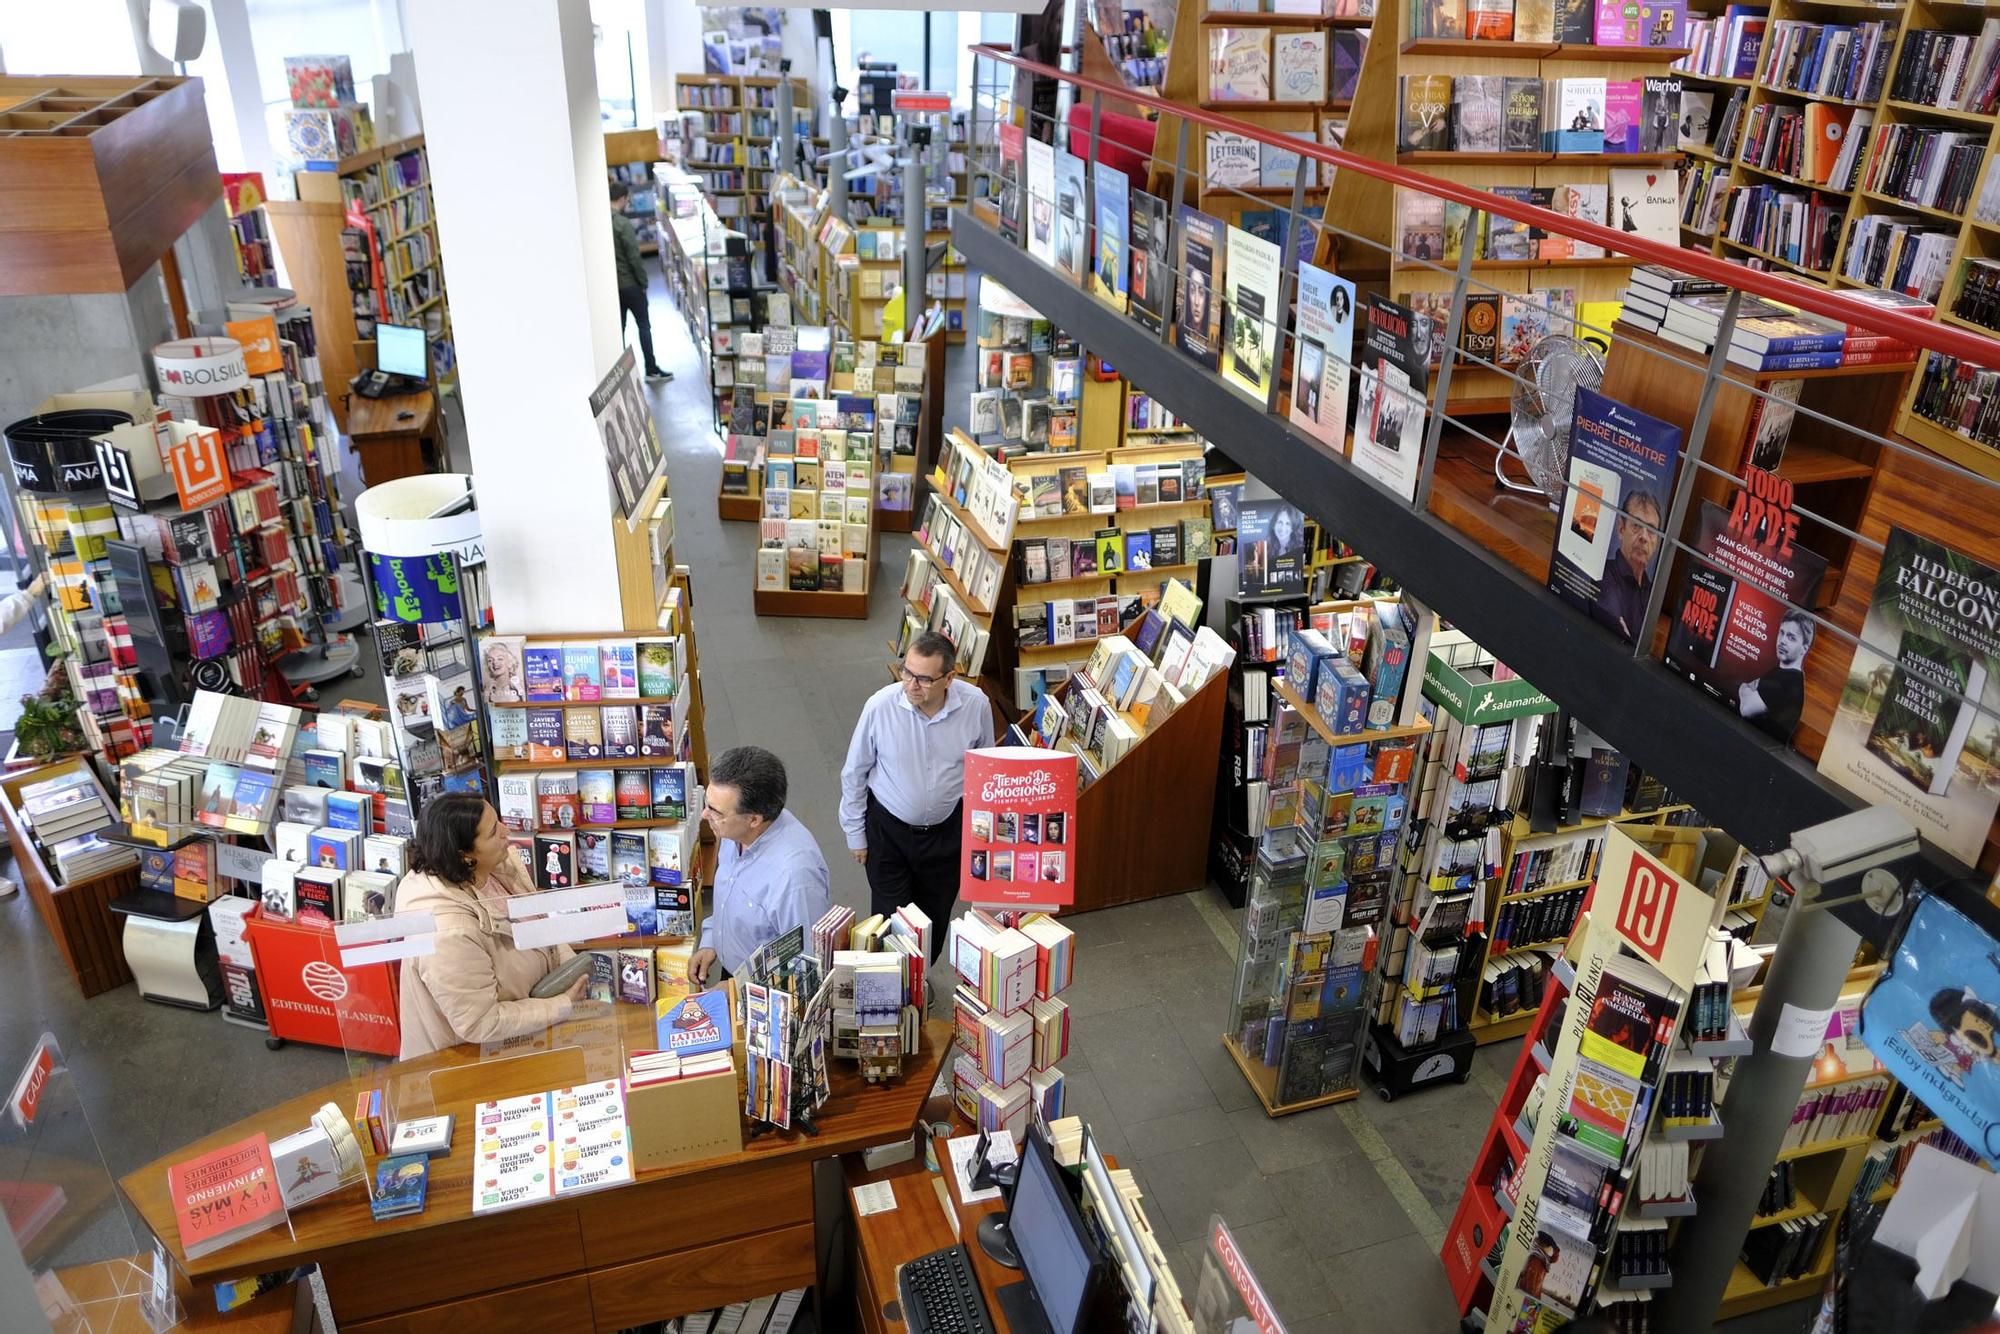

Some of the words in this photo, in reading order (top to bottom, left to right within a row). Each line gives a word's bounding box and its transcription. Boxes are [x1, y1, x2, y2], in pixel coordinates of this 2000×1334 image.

[1566, 86, 1603, 95] SOROLLA
[1646, 79, 1682, 92] Warhol
[1419, 111, 1436, 128] V
[1211, 145, 1257, 162] LETTERING
[1368, 304, 1409, 339] REVOLUCIÓN
[770, 343, 795, 353] 2023
[1376, 333, 1397, 349] ARTURO
[1466, 334, 1496, 350] TESEO
[1851, 340, 1877, 348] ARTURO
[1846, 353, 1872, 361] ARTURO
[1576, 415, 1610, 441] PIERRE
[1612, 432, 1667, 467] LEMAITRE
[825, 470, 845, 479] ATEN
[1745, 465, 1794, 510] TODO
[1727, 490, 1800, 559] ARDE
[1716, 533, 1736, 549] JUAN
[1736, 544, 1795, 580] GÓMEZ-JURADO
[1716, 546, 1737, 563] SIEMPRE
[1737, 556, 1755, 572] GANAN
[389, 558, 422, 613] booket
[1692, 585, 1718, 613] TODO
[1739, 600, 1763, 618] VUELVE
[1895, 566, 2000, 634] FALCON
[1682, 600, 1718, 641] ARDE
[1736, 609, 1743, 617] EL
[1744, 614, 1767, 630] AUTOR
[1899, 602, 1910, 614] DE
[1911, 608, 1923, 620] LA
[1923, 613, 1957, 637] NOVELA
[1900, 592, 1932, 615] VUELVE
[1931, 608, 1942, 620] EL
[1942, 613, 1970, 634] GRAN
[1733, 618, 1747, 630] MÁS
[1747, 625, 1768, 641] LEÍDO
[1729, 632, 1760, 654] 2.500.000
[565, 656, 595, 664] RUMBO
[1907, 649, 1957, 680] ILDEFONSO
[1424, 671, 1462, 709] alamandra
[1905, 677, 1943, 703] ESCLAVA
[1907, 689, 1919, 702] DE
[1919, 694, 1933, 710] LA
[1492, 692, 1552, 711] salamandra
[1894, 693, 1940, 727] LIBERTAD
[993, 773, 1032, 789] TIEMPO
[1033, 769, 1052, 784] DE
[1234, 755, 1242, 787] RBA
[981, 781, 1056, 802] EMOCIONES
[624, 887, 649, 895] JAVIER
[621, 964, 647, 988] 64
[226, 972, 254, 1008] 1795
[857, 985, 884, 993] HIJOS
[1612, 988, 1646, 1009] CUANDO
[271, 998, 335, 1016] EDITORIAL
[336, 1009, 394, 1026] PLANETA
[1601, 997, 1651, 1024] INMORTALES
[1612, 996, 1643, 1013] FUIMOS
[1572, 1007, 1590, 1039] PLAZA
[27, 1065, 46, 1105] CAJA
[1883, 1036, 1925, 1073] ¡Estoy
[1921, 1069, 1989, 1131] indignada!
[579, 1090, 614, 1101] CEREBRO
[579, 1099, 597, 1107] GYM
[504, 1105, 541, 1116] MEMORIA
[504, 1114, 521, 1122] GYM
[1540, 1128, 1557, 1170] Galaxia
[1552, 1070, 1571, 1130] Gutenberg
[500, 1131, 540, 1143] NEURONAS
[579, 1124, 596, 1132] GYM
[500, 1140, 518, 1149] GYM
[580, 1140, 622, 1153] ALZHEIMER
[581, 1150, 599, 1158] ANTI
[184, 1146, 261, 1181] INDEPENDIENTES
[500, 1156, 534, 1168] AGILIDAD
[501, 1152, 530, 1162] MENTAL
[500, 1165, 518, 1174] GYM
[1551, 1163, 1567, 1176] LAURA
[501, 1194, 519, 1202] GYM
[192, 1193, 271, 1230] REVISTA
[1516, 1194, 1537, 1251] DEBATE
